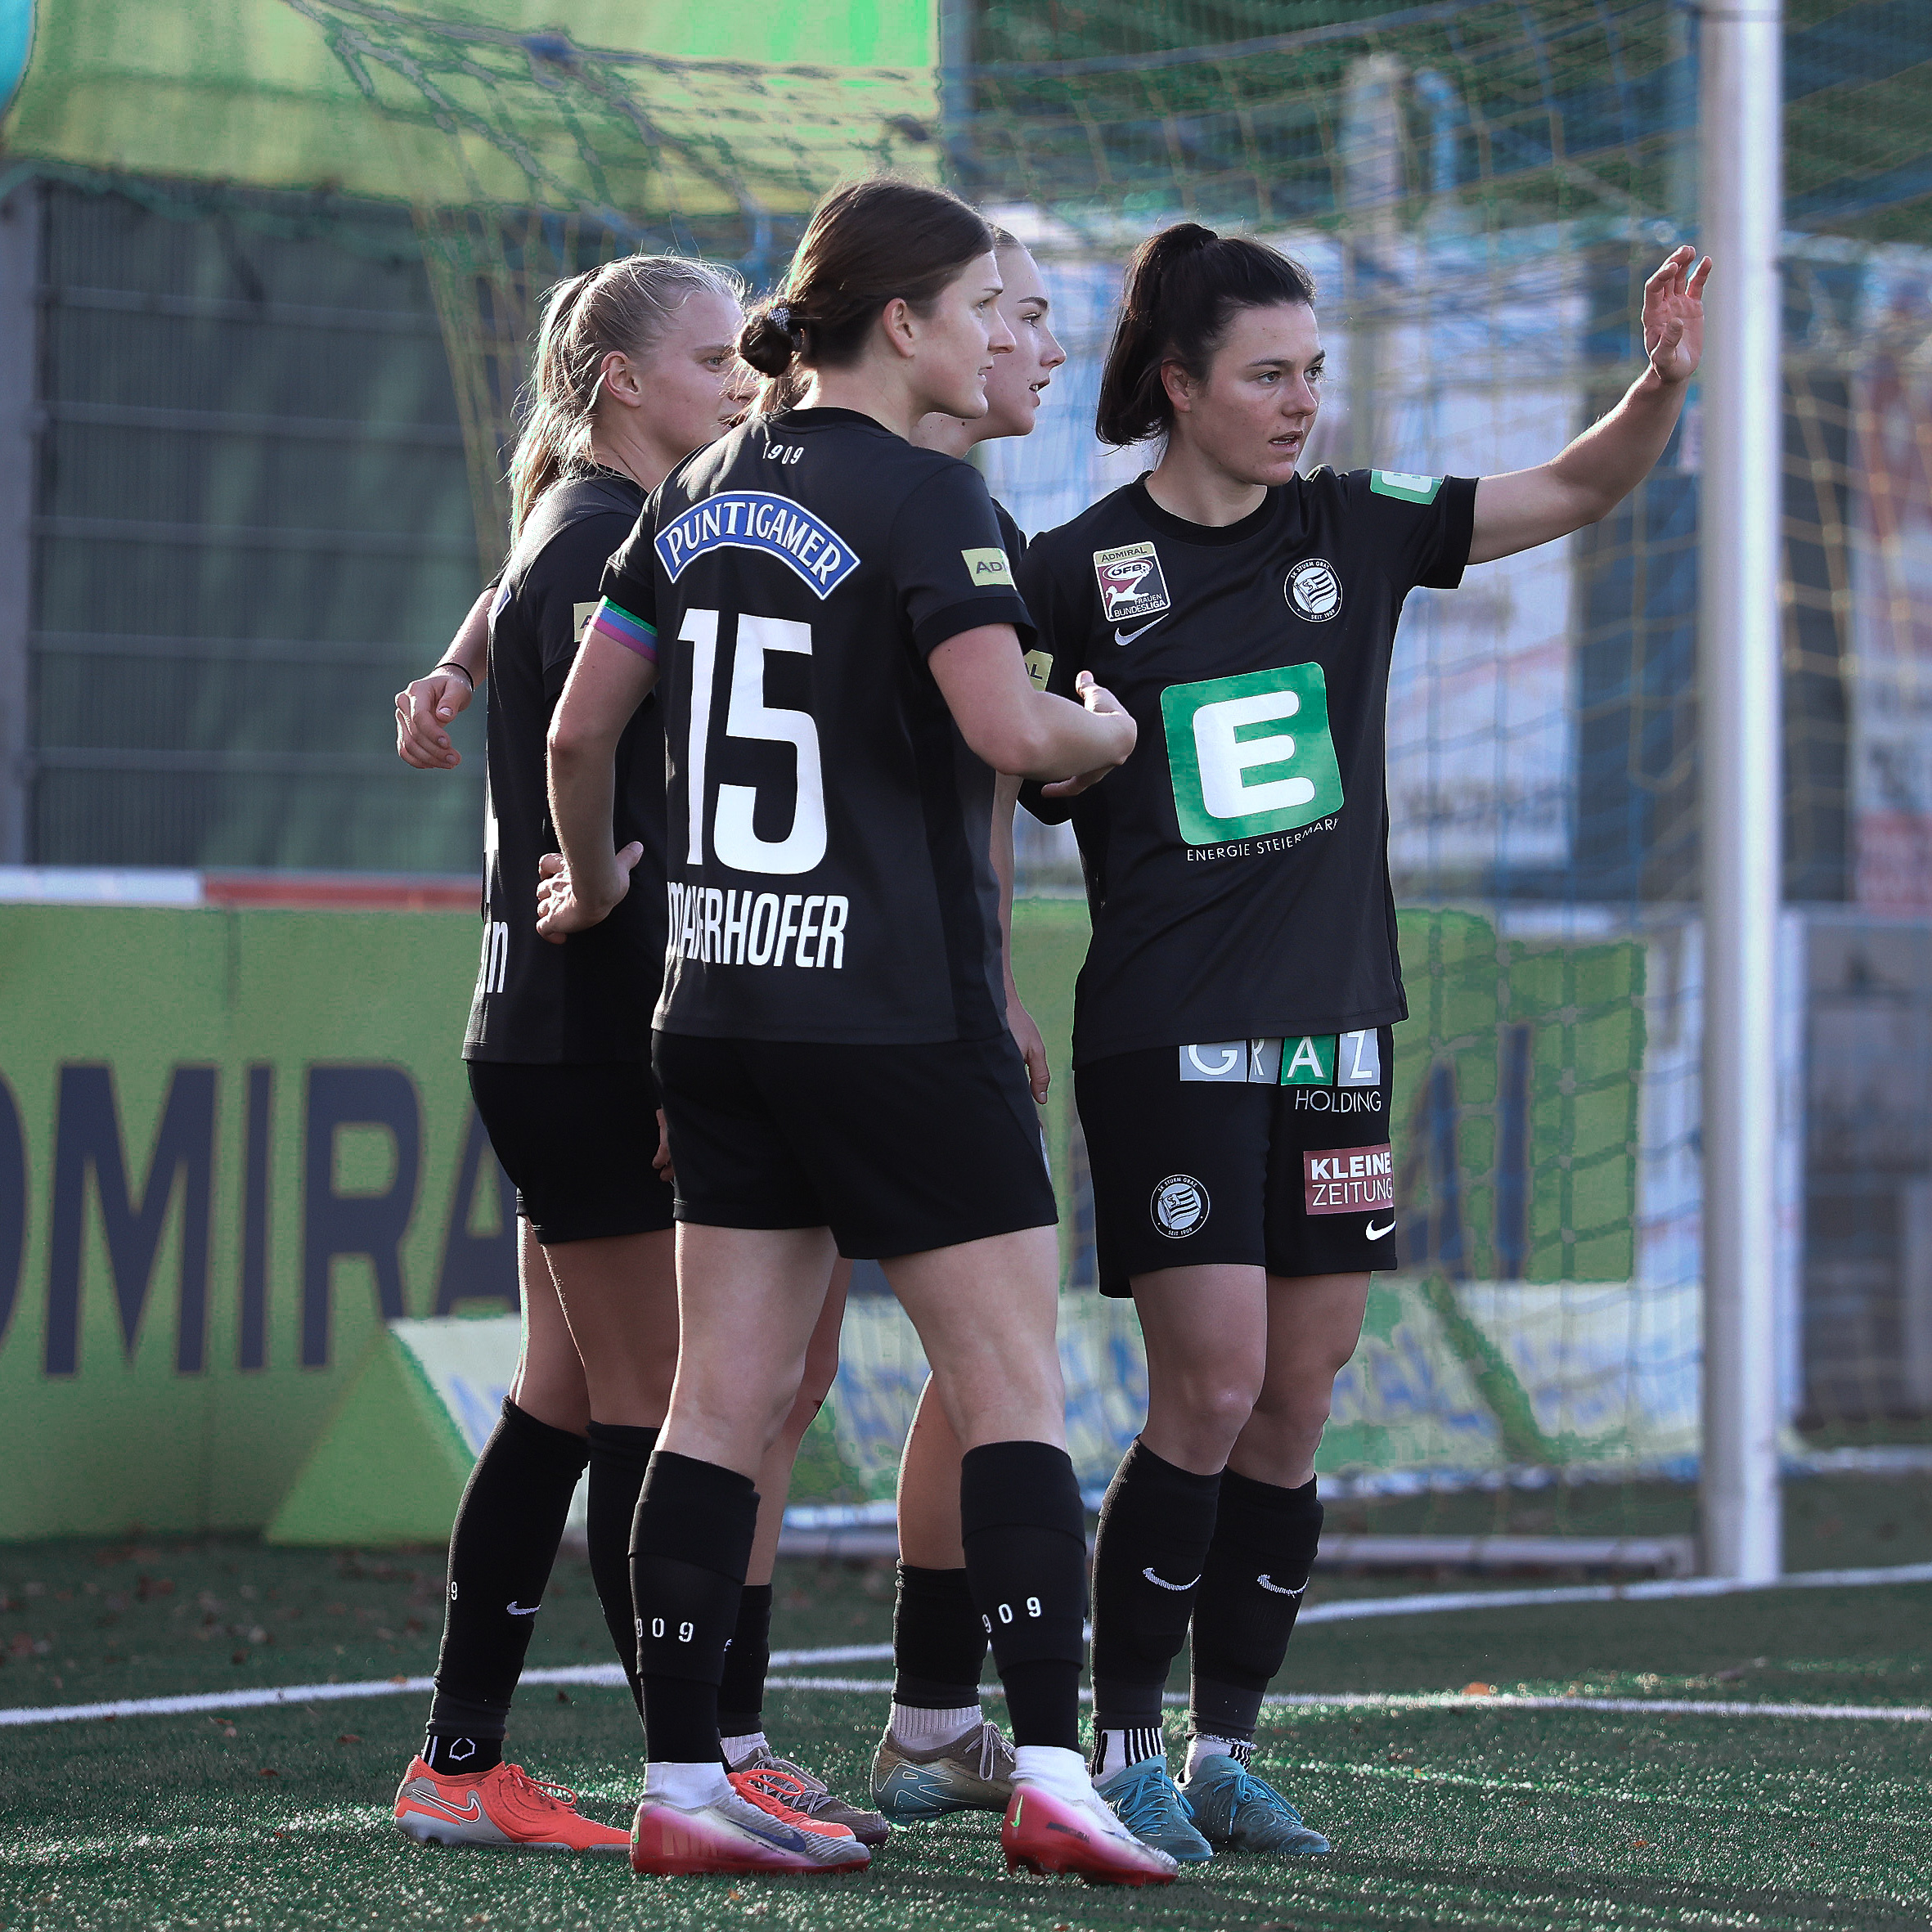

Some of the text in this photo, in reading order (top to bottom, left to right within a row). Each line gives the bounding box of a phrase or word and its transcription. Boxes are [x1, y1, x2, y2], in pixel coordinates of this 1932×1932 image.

[762, 441, 803, 464] 1909
[666, 501, 841, 586] PUNTIGAMER
[1101, 546, 1147, 563] ADMIRAL
[1296, 561, 1314, 572] STURM
[1315, 561, 1330, 570] GRAZ
[1113, 600, 1166, 618] BUNDESLIGA
[1134, 593, 1162, 605] FRAUEN
[677, 608, 828, 875] 15
[1193, 690, 1316, 819] E
[1187, 843, 1251, 861] ENERGIE
[1188, 1029, 1373, 1079] GRAZ
[1294, 1090, 1382, 1113] HOLDING
[1310, 1151, 1391, 1180] KLEINE
[1165, 1177, 1181, 1186] STURM
[1183, 1177, 1198, 1188] GRAZ
[1311, 1178, 1392, 1206] ZEITUNG
